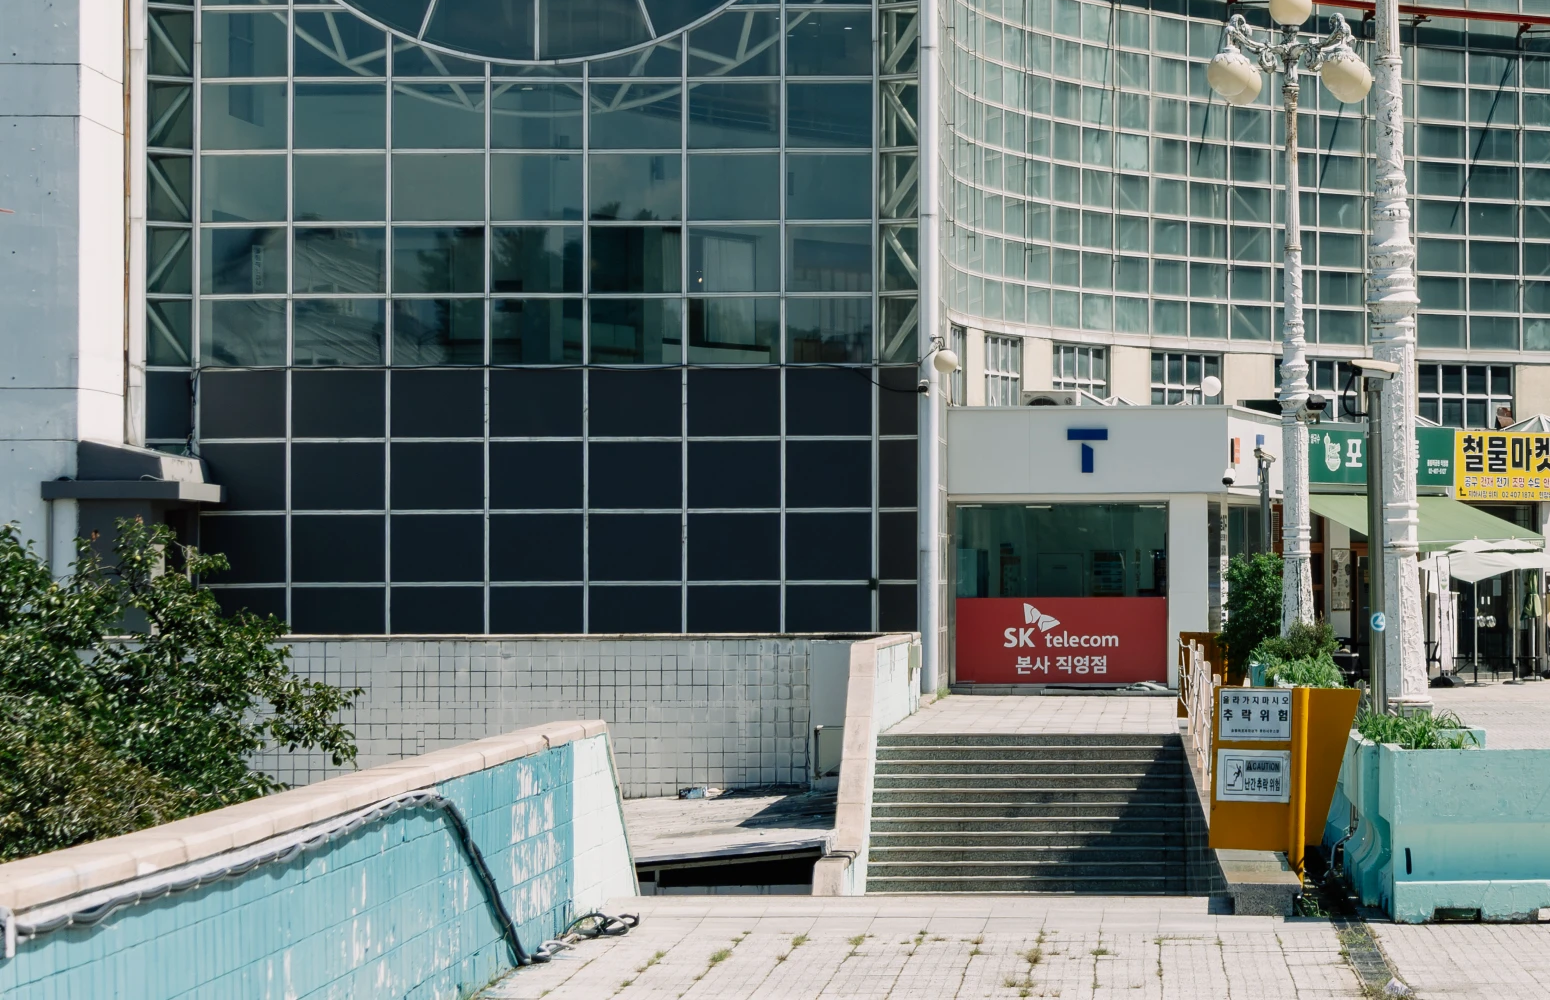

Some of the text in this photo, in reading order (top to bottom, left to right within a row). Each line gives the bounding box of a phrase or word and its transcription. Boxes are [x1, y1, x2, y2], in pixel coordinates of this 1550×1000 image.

[1067, 429, 1108, 473] T
[1465, 476, 1478, 488] 공구
[1496, 477, 1510, 488] 전기
[1528, 477, 1541, 488] 수도
[1510, 491, 1521, 499] 407
[1003, 627, 1119, 648] SK telecom
[1015, 655, 1107, 675] 본사 직영점
[1252, 762, 1280, 771] CAUTION
